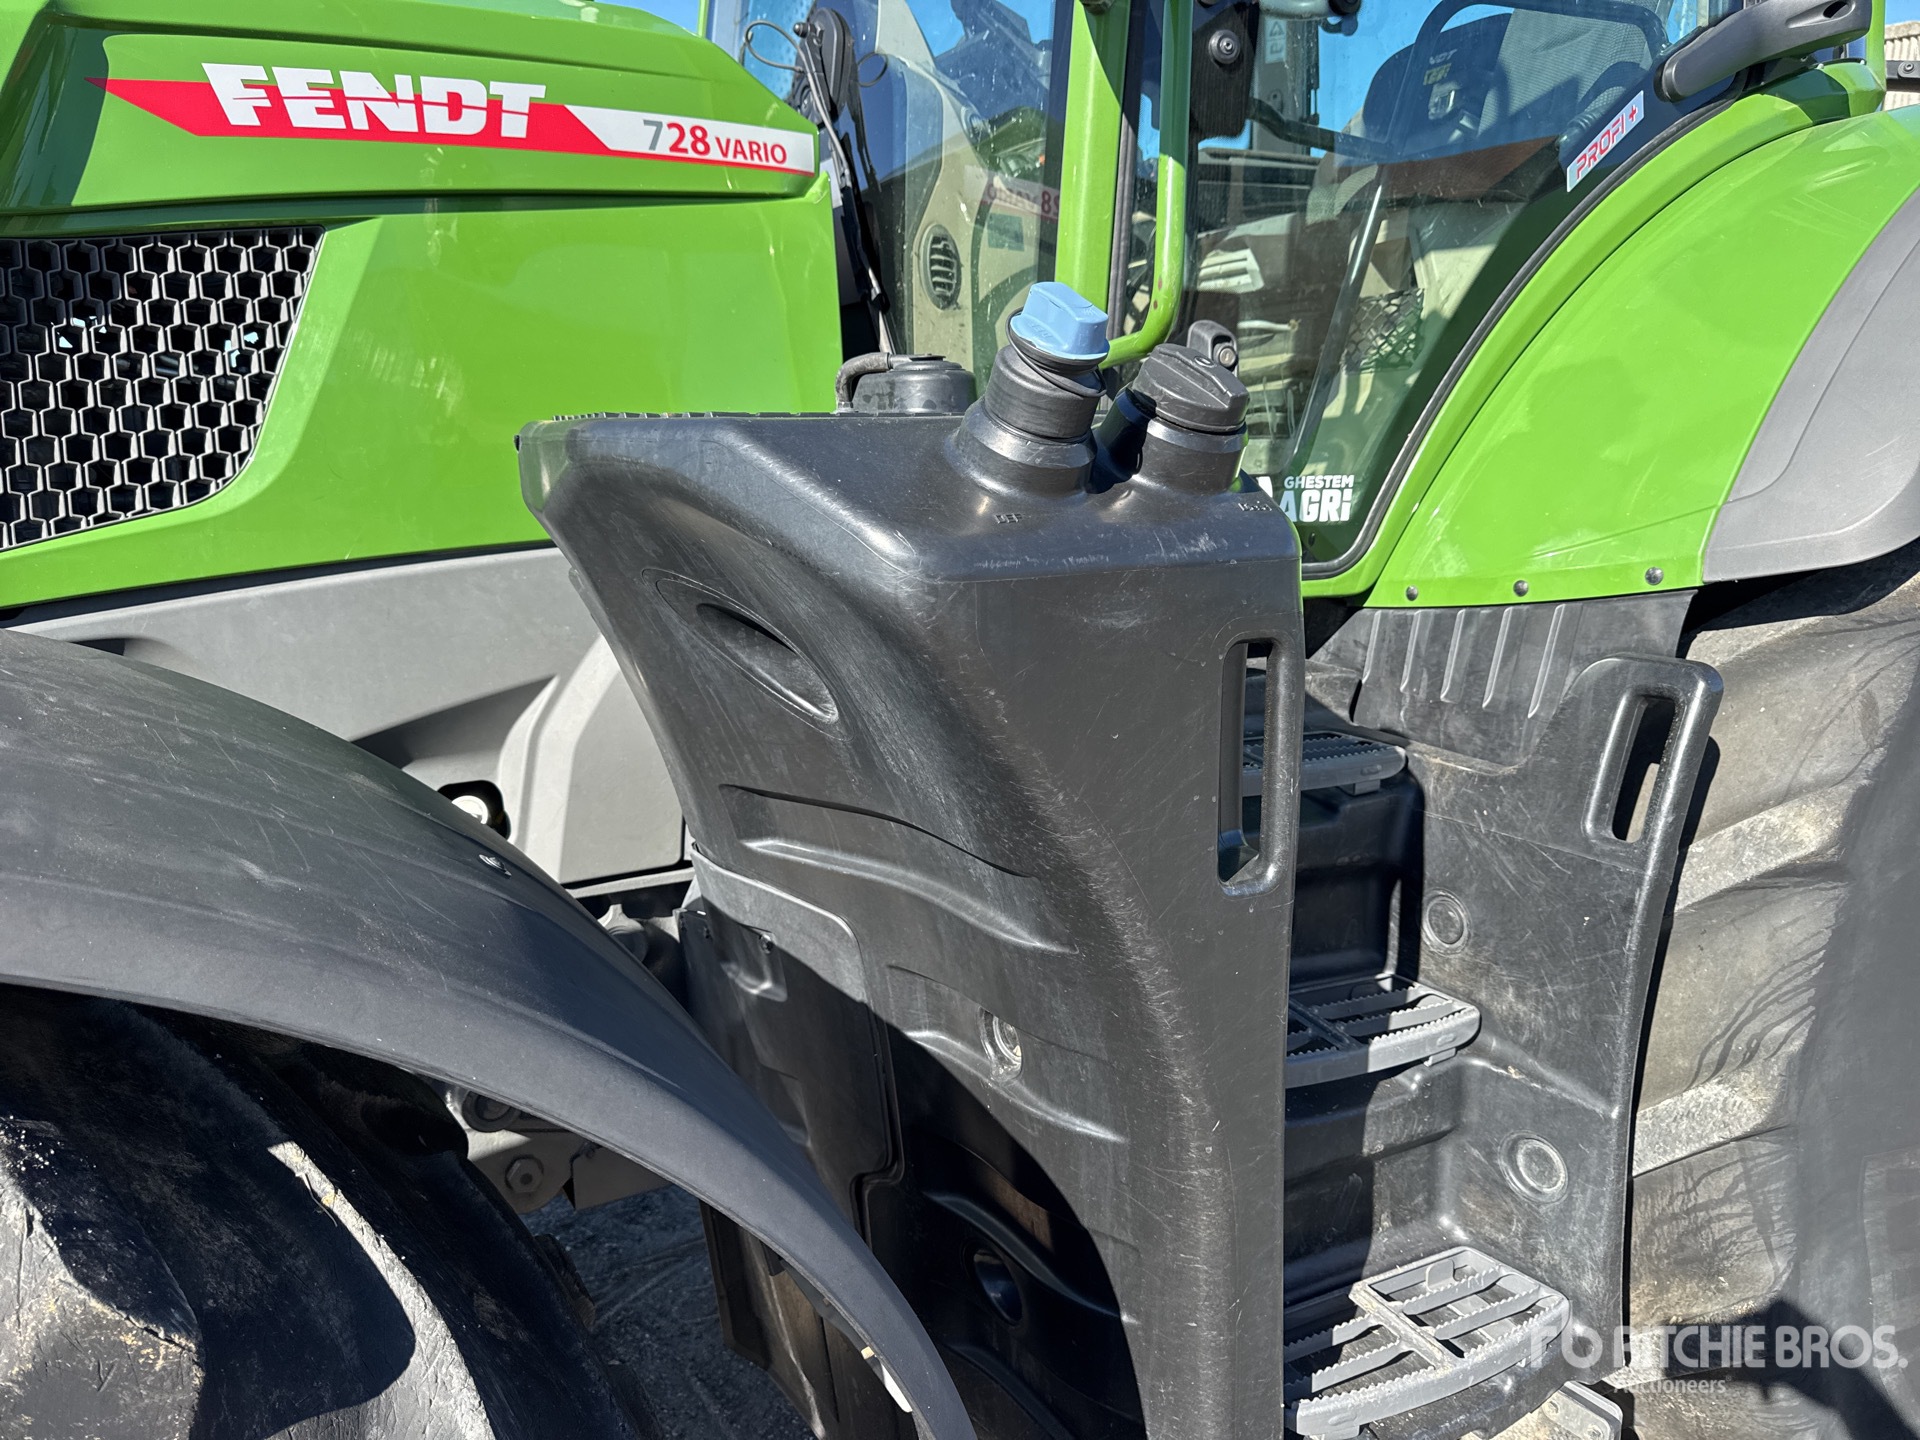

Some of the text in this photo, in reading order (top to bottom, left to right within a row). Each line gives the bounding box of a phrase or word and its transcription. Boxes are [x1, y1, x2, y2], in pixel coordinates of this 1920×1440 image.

[201, 63, 546, 138] FENDT
[643, 119, 787, 164] 728 VARIO
[1576, 113, 1626, 180] PROFI
[1284, 475, 1355, 489] GHESTEM
